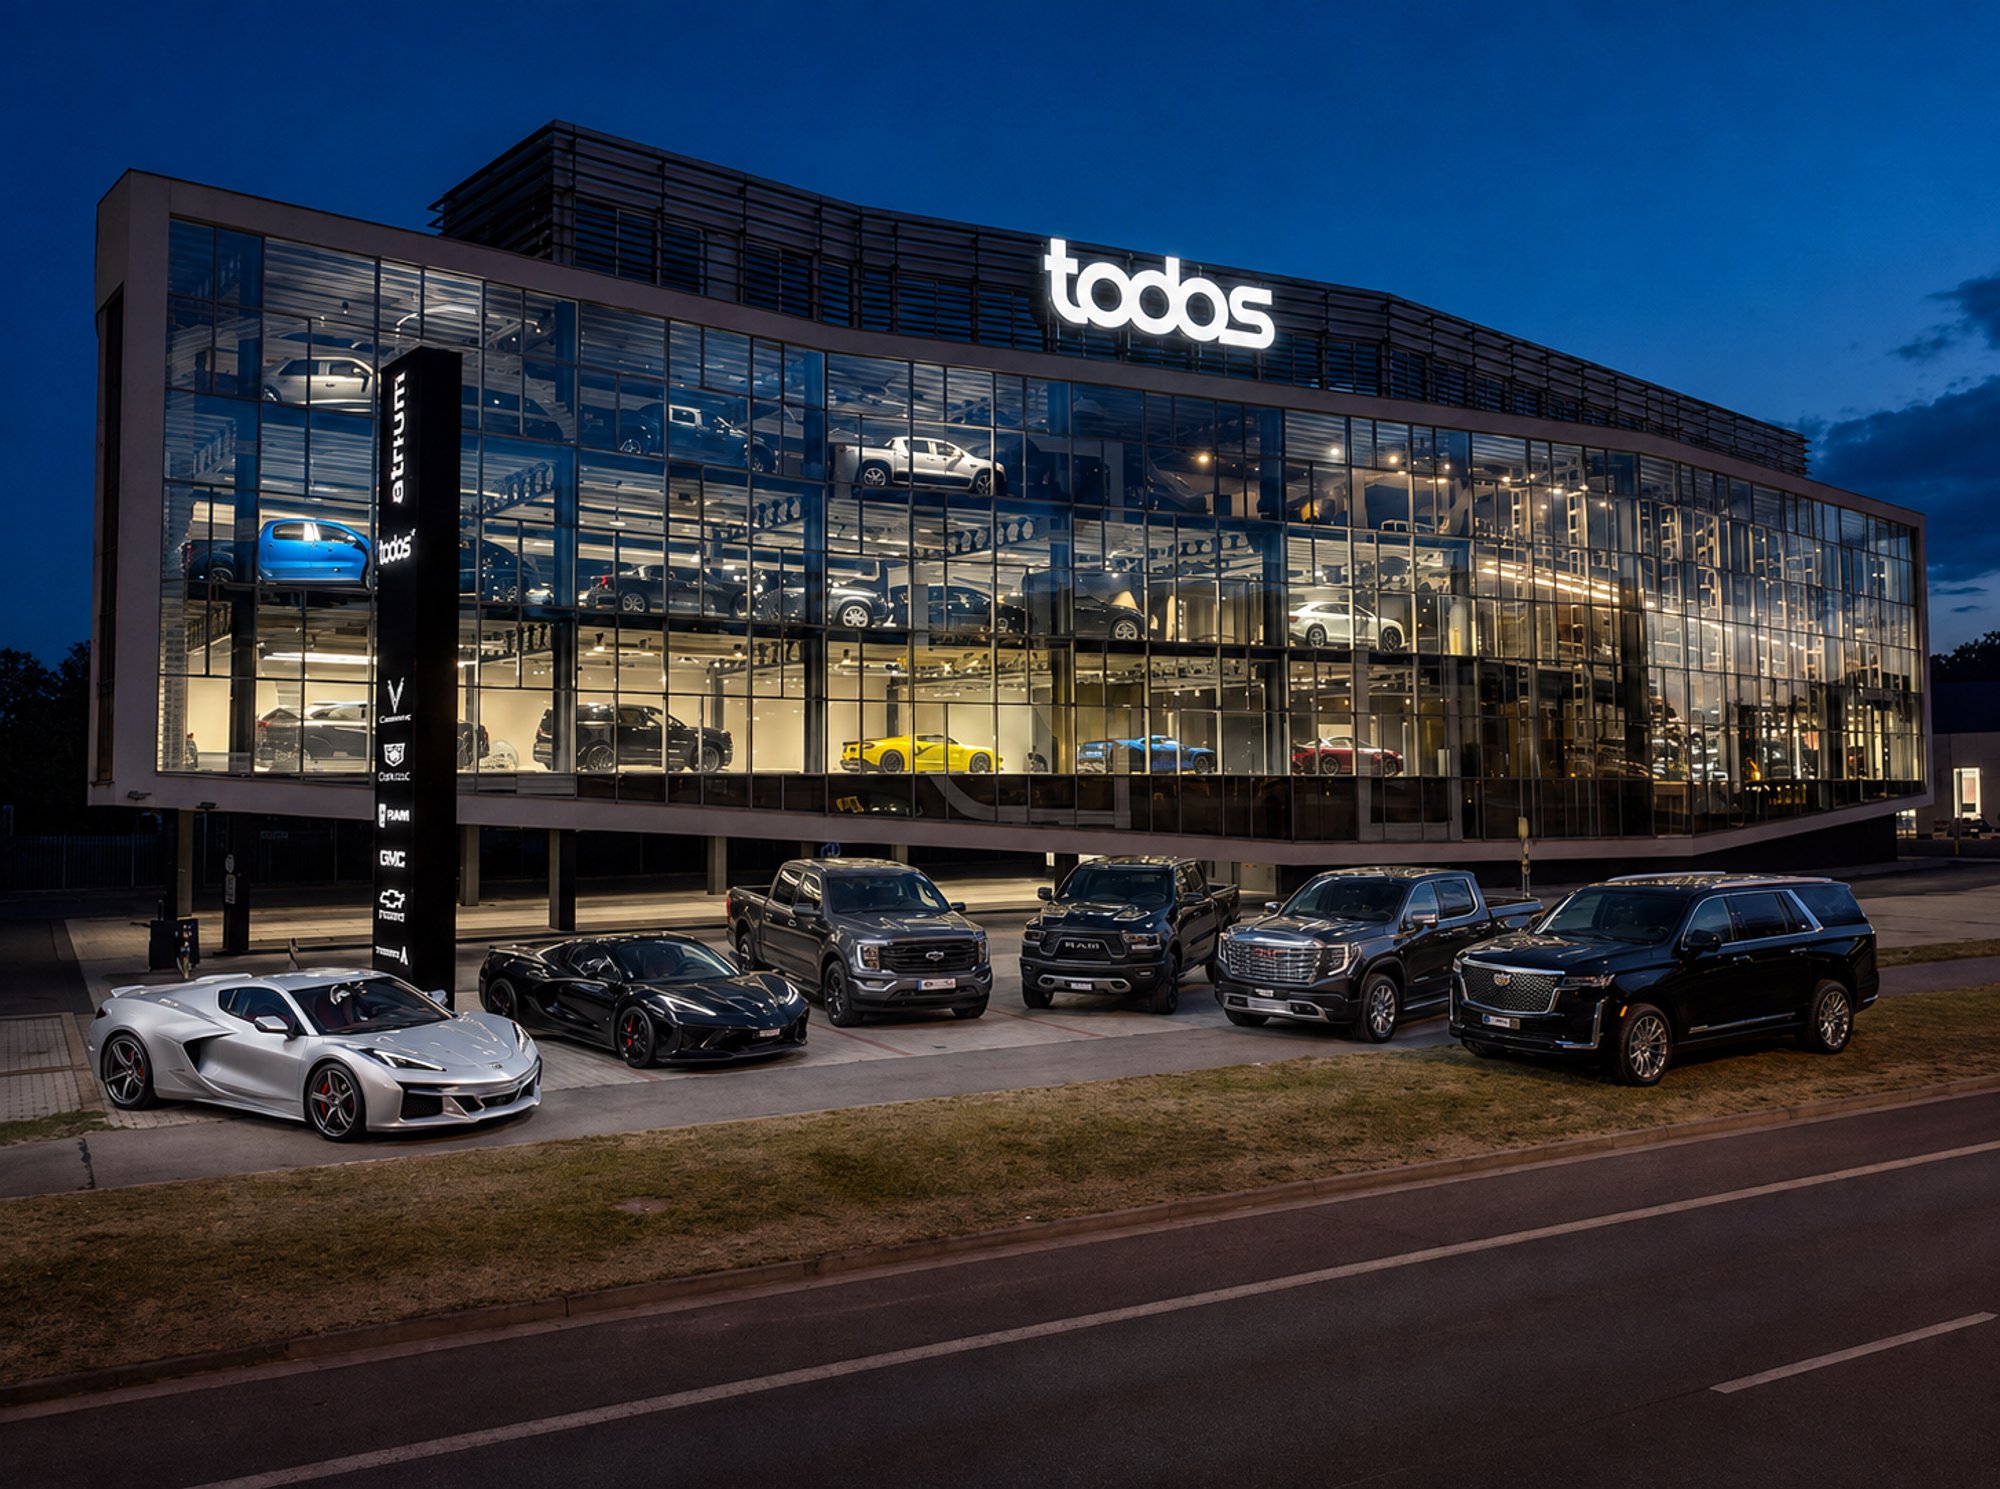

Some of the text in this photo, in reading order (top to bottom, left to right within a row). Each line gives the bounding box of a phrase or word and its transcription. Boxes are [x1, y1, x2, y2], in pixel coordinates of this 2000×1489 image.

[1044, 237, 1276, 350] todos
[391, 371, 406, 504] atrium
[379, 533, 412, 565] todos
[387, 809, 410, 822] RAM
[380, 850, 406, 868] GMC
